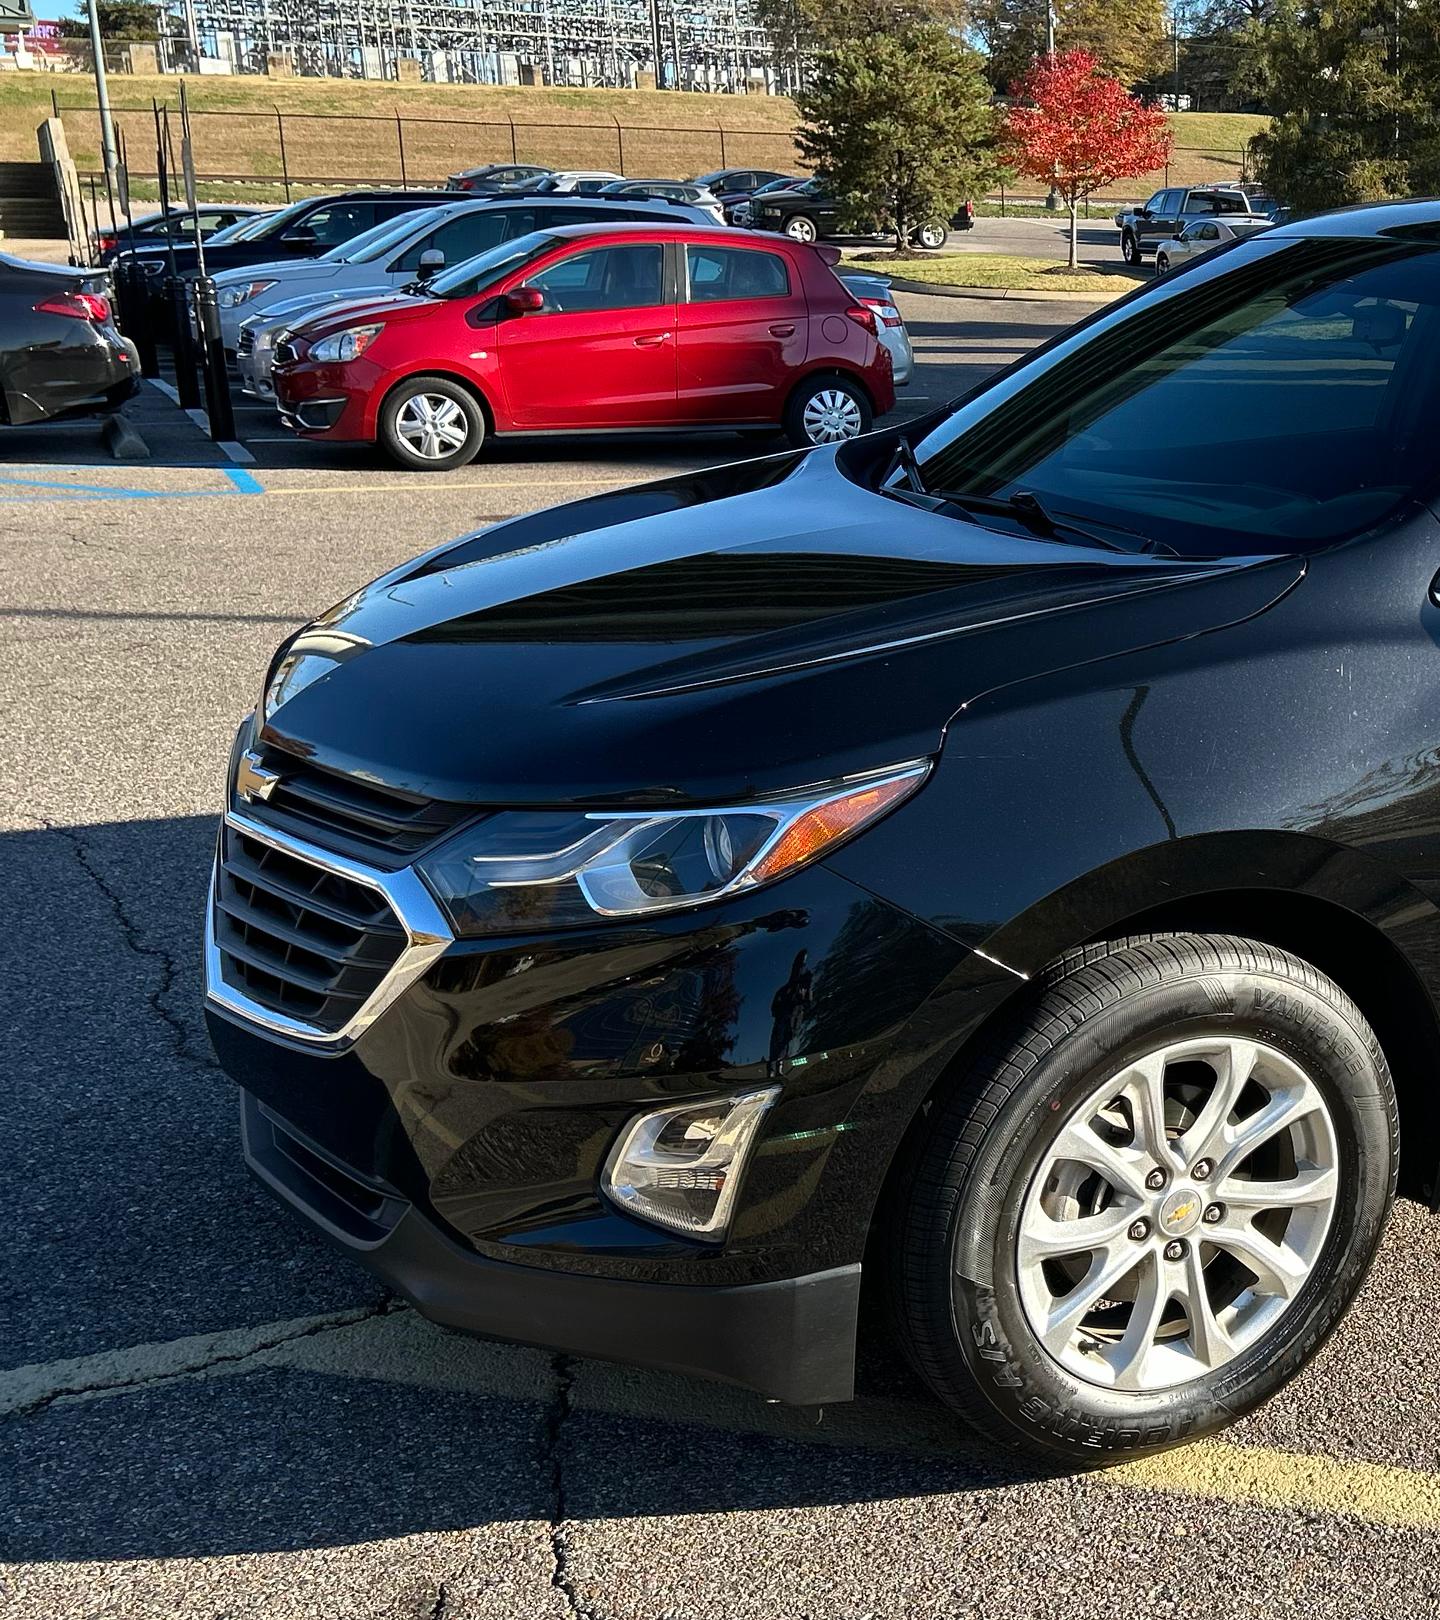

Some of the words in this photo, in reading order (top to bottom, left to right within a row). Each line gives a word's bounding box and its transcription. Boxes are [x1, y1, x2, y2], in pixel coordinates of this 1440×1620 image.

[1253, 987, 1366, 1077] VANTAGE
[970, 1319, 1024, 1388] A/S
[1018, 1396, 1188, 1449] TOURING
